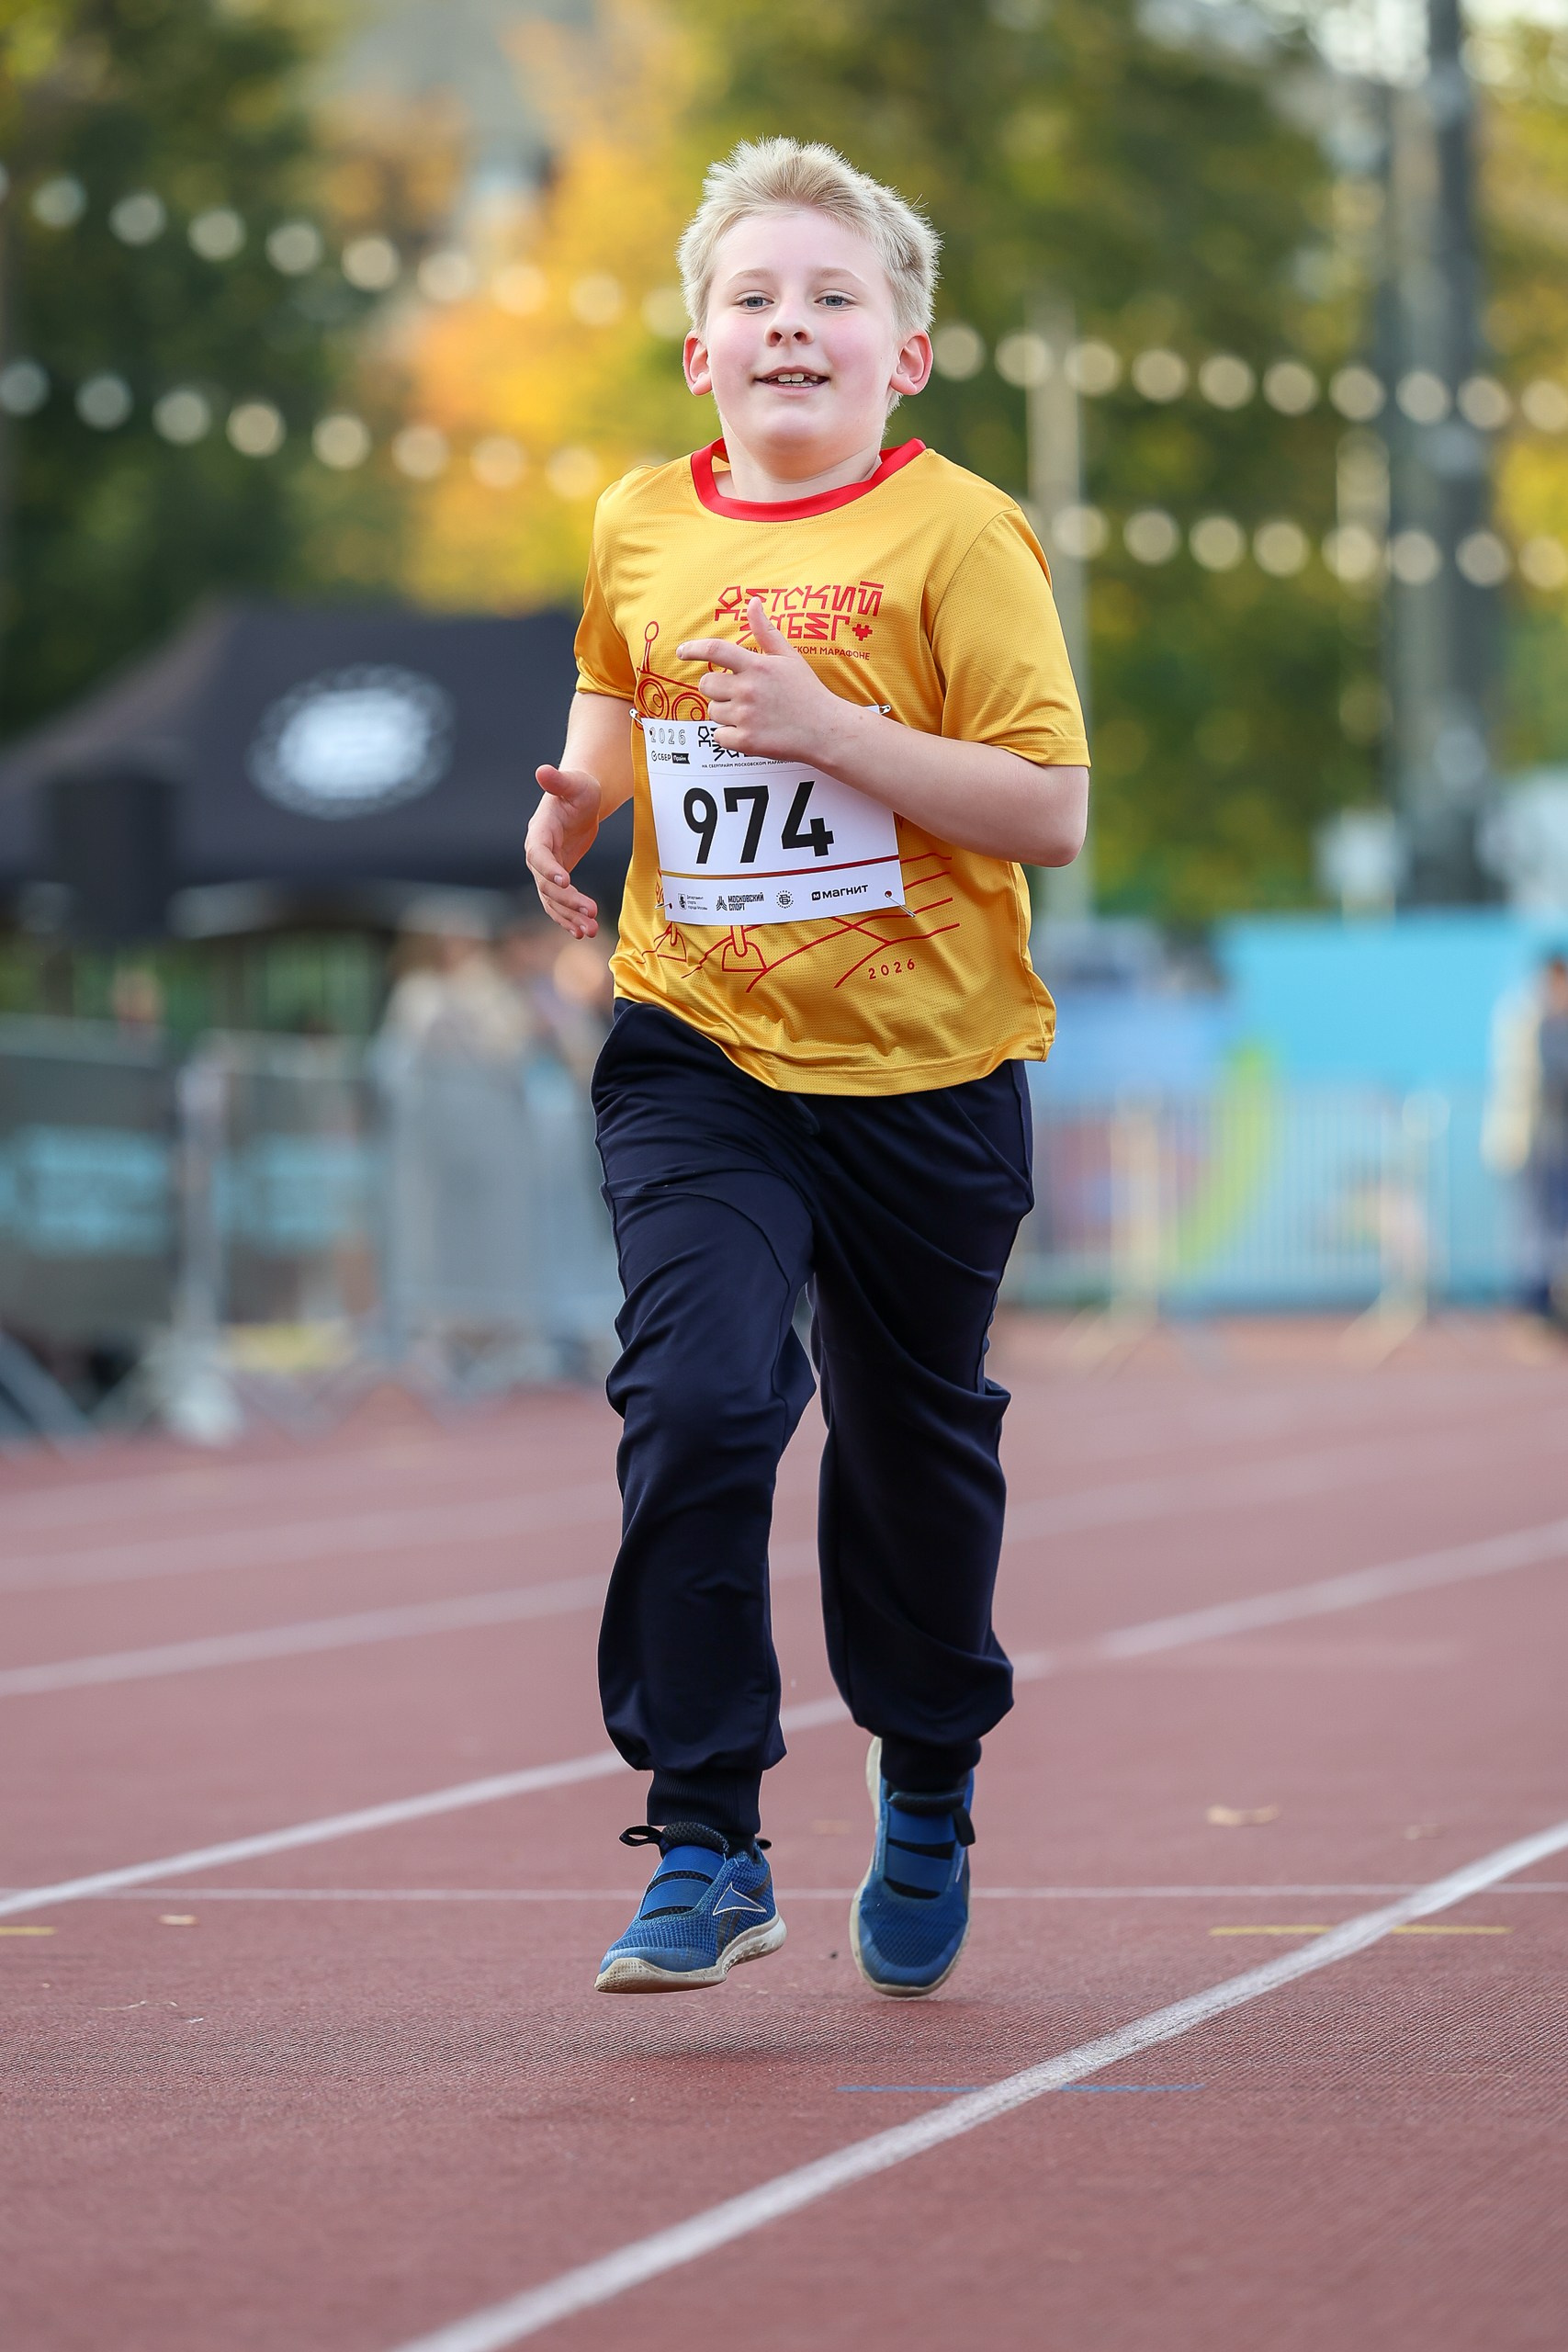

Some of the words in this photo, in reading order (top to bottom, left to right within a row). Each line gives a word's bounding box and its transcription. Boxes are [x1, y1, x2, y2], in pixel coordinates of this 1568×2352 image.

[819, 647, 871, 661] МАРАФОНЕ
[649, 727, 686, 745] 2026
[658, 752, 671, 762] СБЕР
[683, 781, 835, 864] 974
[728, 892, 764, 903] МОСКОВСКИЙ
[729, 902, 745, 910] СПОРТ
[868, 958, 915, 979] 2026
